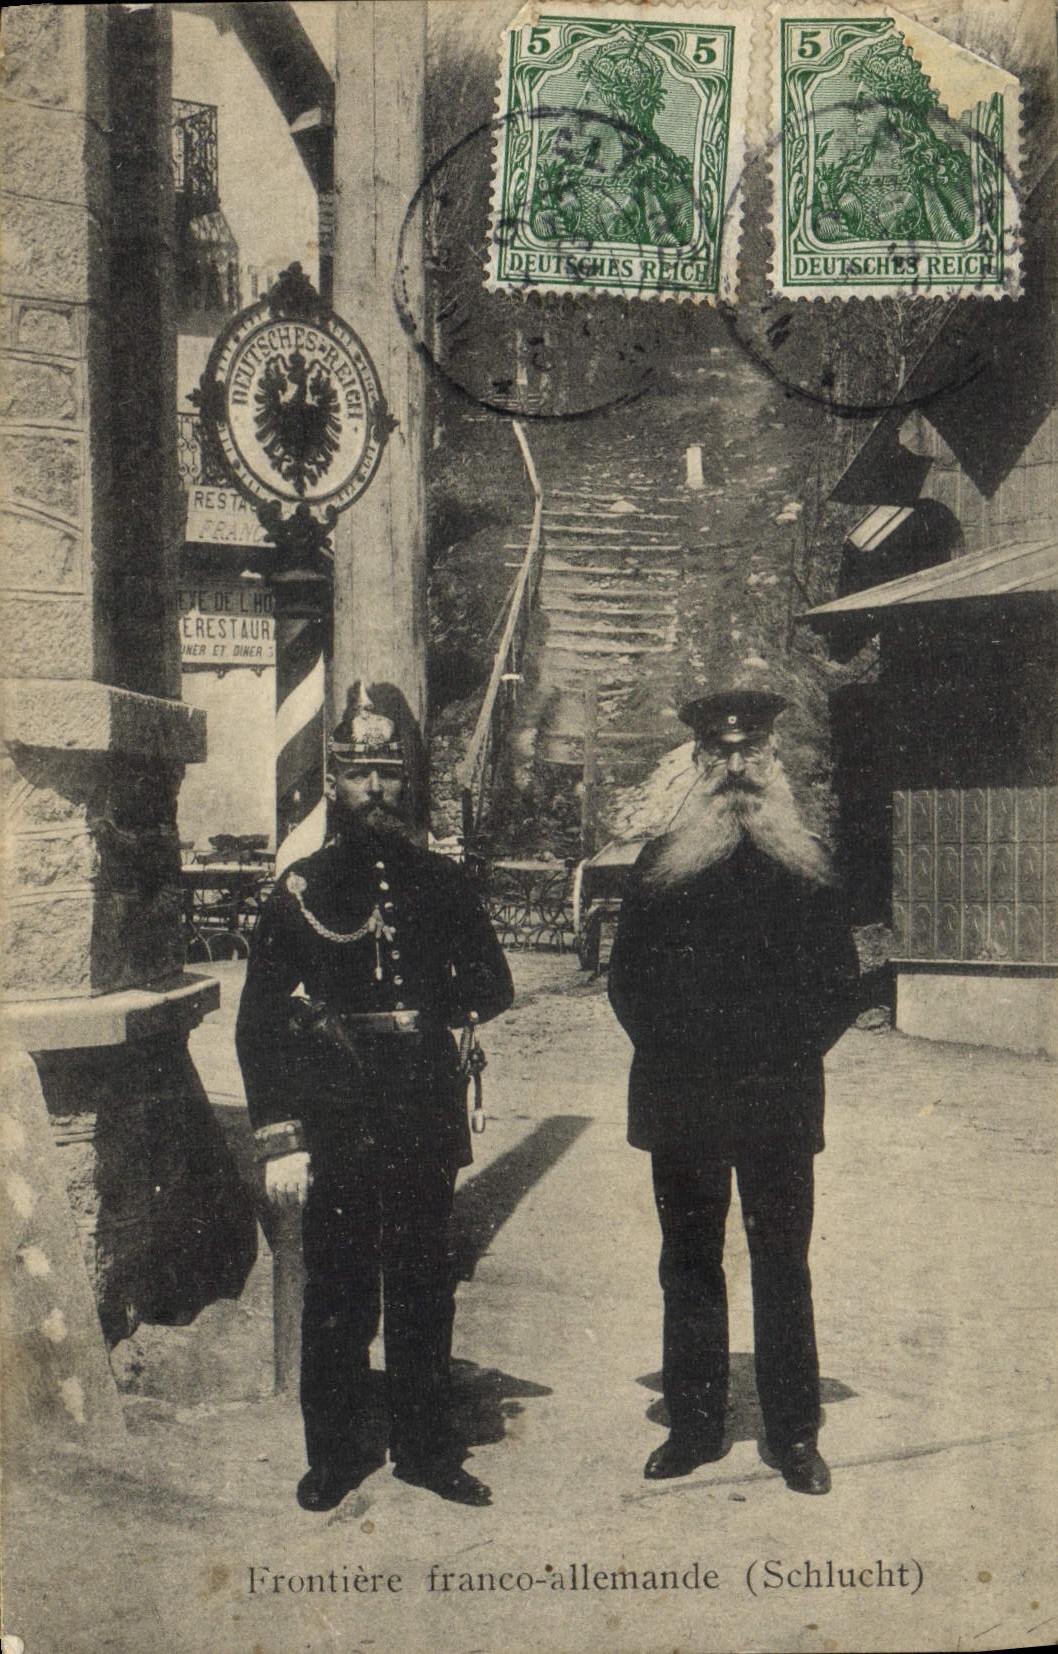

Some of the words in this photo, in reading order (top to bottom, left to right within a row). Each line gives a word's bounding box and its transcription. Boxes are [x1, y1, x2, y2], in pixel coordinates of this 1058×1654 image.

[527, 27, 551, 56] 5
[692, 36, 718, 65] 5
[797, 29, 823, 59] 5
[508, 252, 634, 279] DEUTSCHES
[642, 259, 710, 282] REICH
[793, 255, 918, 277] DEUTSCHES
[926, 254, 995, 276] REICH
[321, 343, 364, 421] REICH
[212, 644, 227, 657] ET
